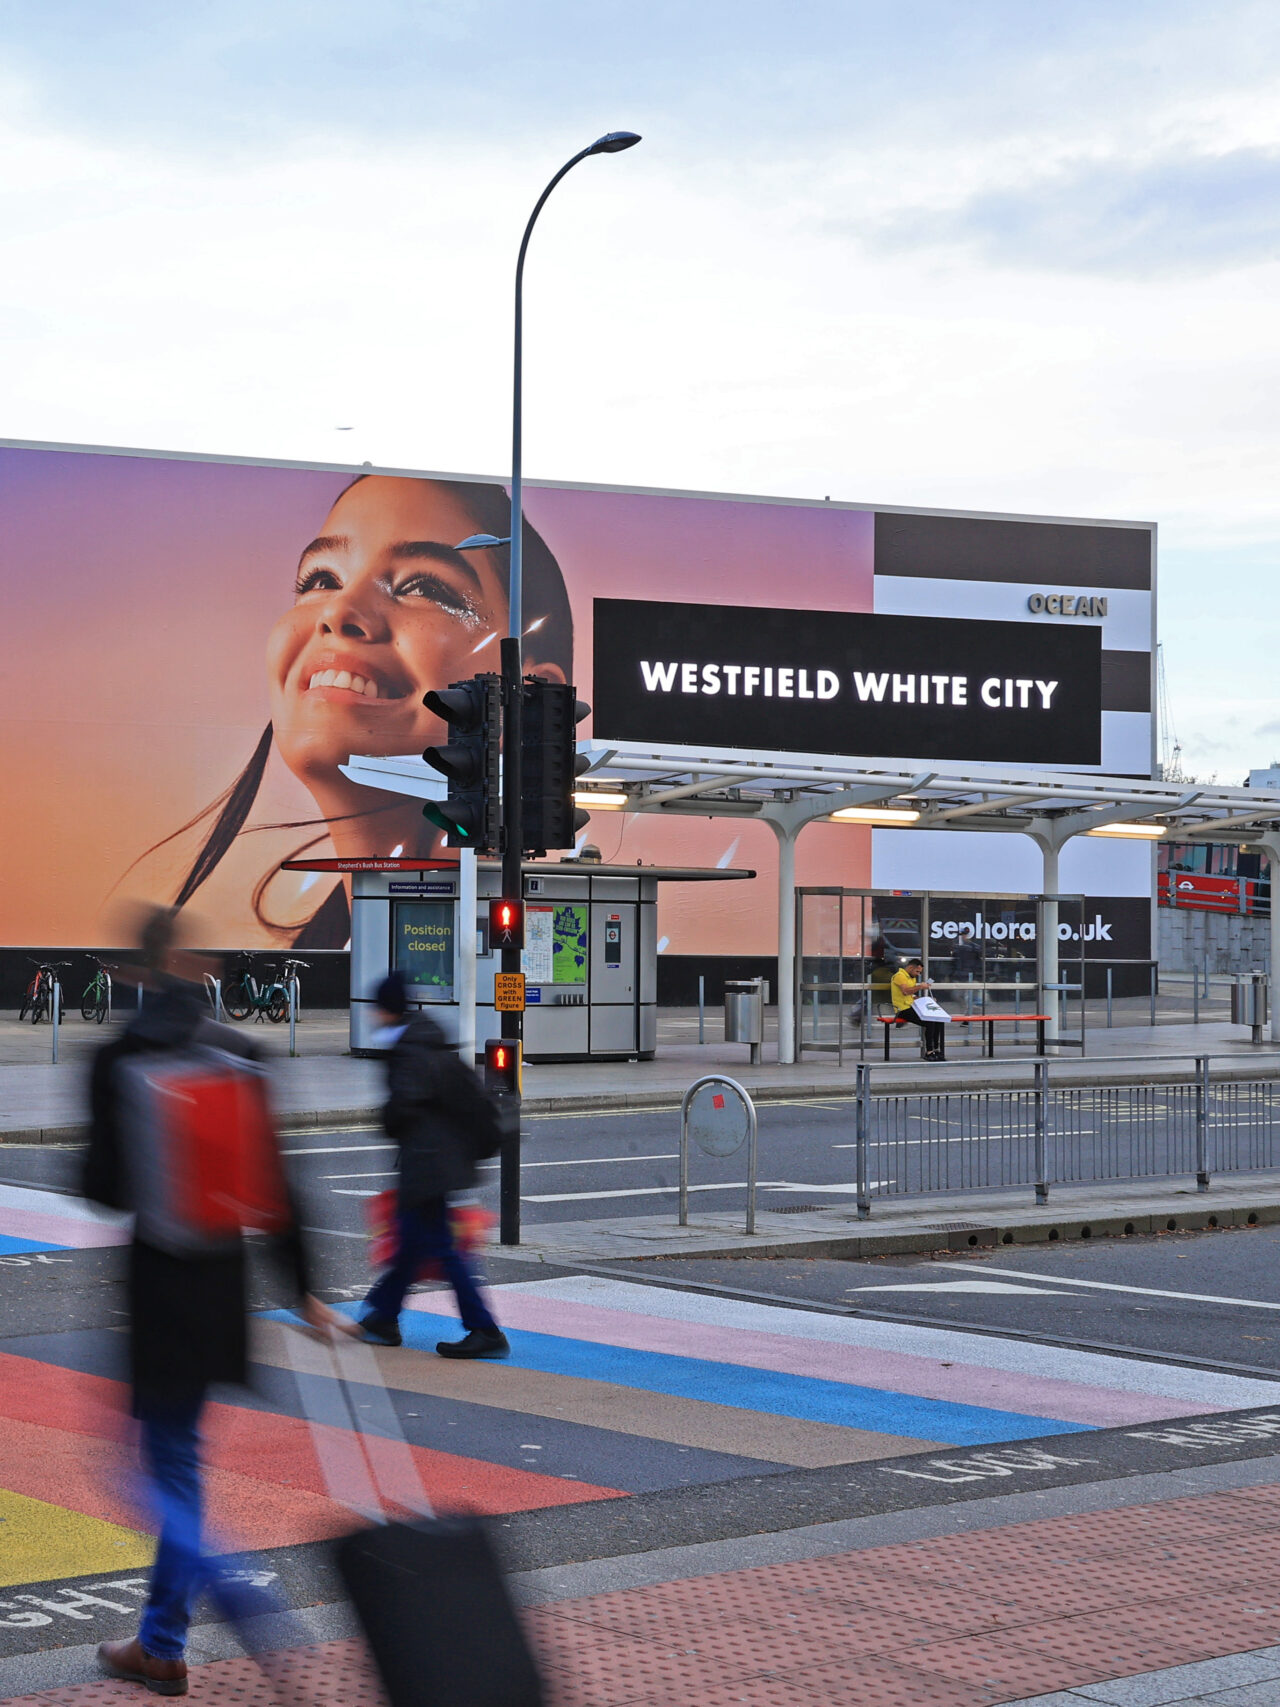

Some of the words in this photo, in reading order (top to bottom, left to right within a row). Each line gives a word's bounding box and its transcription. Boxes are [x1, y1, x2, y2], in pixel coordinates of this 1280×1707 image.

[1028, 593, 1108, 617] OCEAN
[640, 660, 840, 700] WESTFIELD
[853, 671, 968, 706] WHITE
[981, 677, 1059, 709] CITY
[404, 924, 451, 935] Position
[930, 912, 1113, 946] sephorao.uk
[408, 940, 446, 951] closed
[878, 1447, 1100, 1484] LOOK
